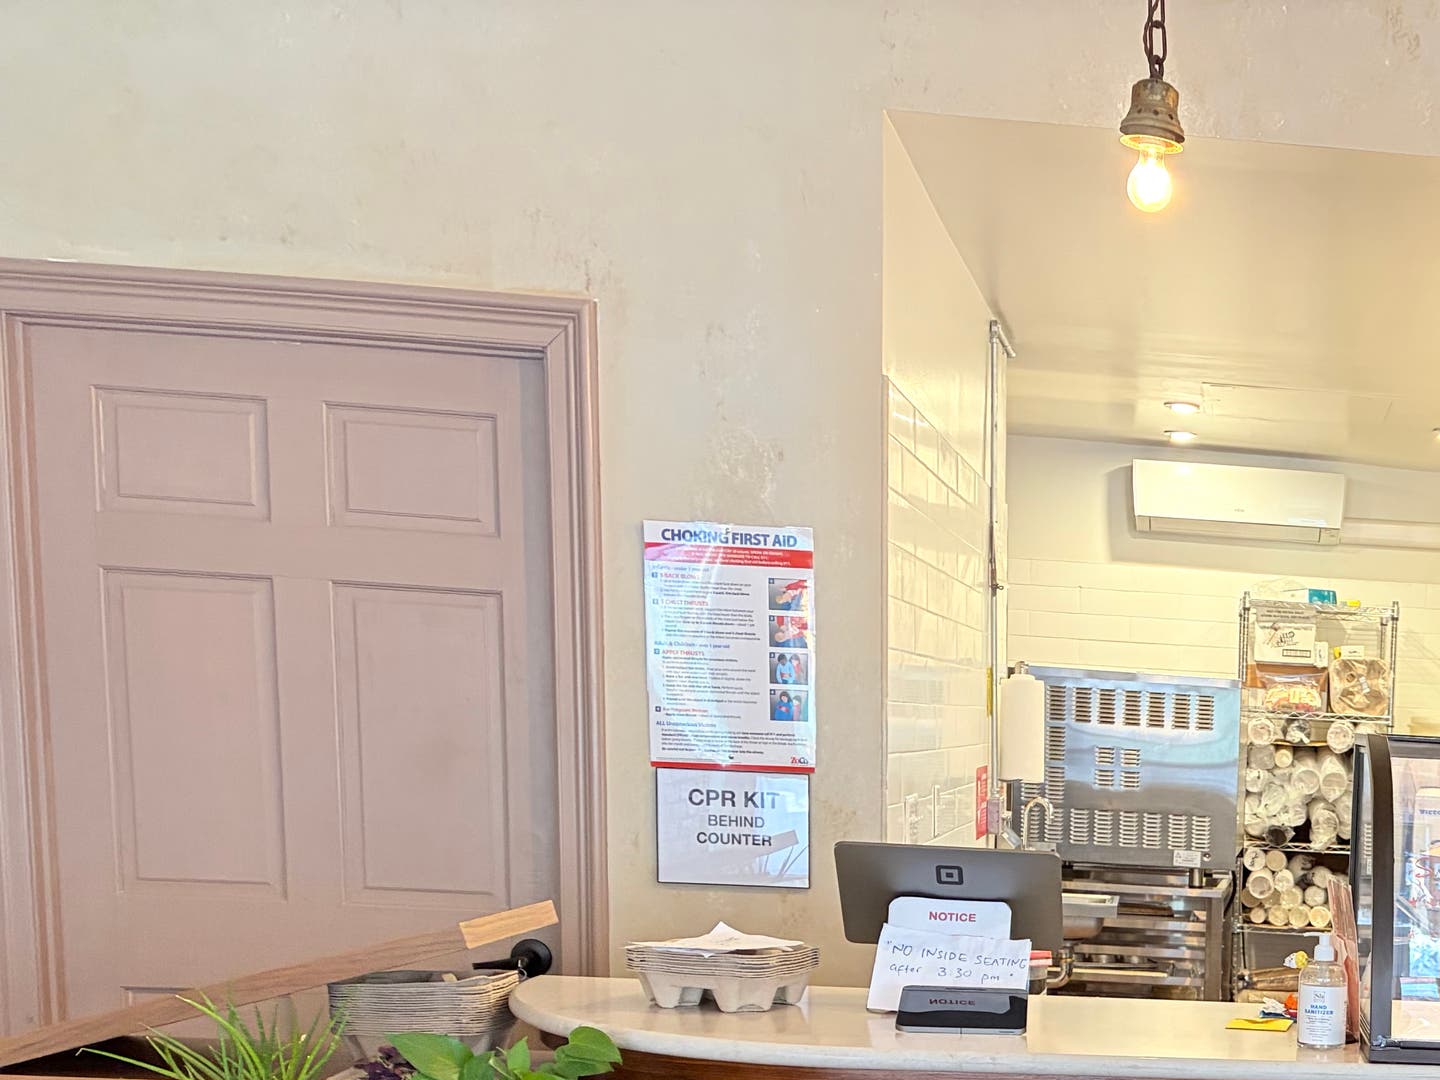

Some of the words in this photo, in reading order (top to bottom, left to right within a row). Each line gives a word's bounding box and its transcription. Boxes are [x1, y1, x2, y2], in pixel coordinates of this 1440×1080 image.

[661, 528, 729, 545] CHOKING
[731, 532, 770, 546] FIRST
[772, 534, 798, 548] AID
[688, 788, 736, 808] CPR
[744, 791, 781, 809] KIT
[708, 814, 765, 829] BEHIND
[696, 831, 772, 847] COUNTER
[928, 911, 976, 923] NOTICE
[921, 947, 968, 963] INSIDE
[974, 954, 1028, 970] SEATING
[889, 963, 922, 976] after
[981, 973, 1000, 985] pm
